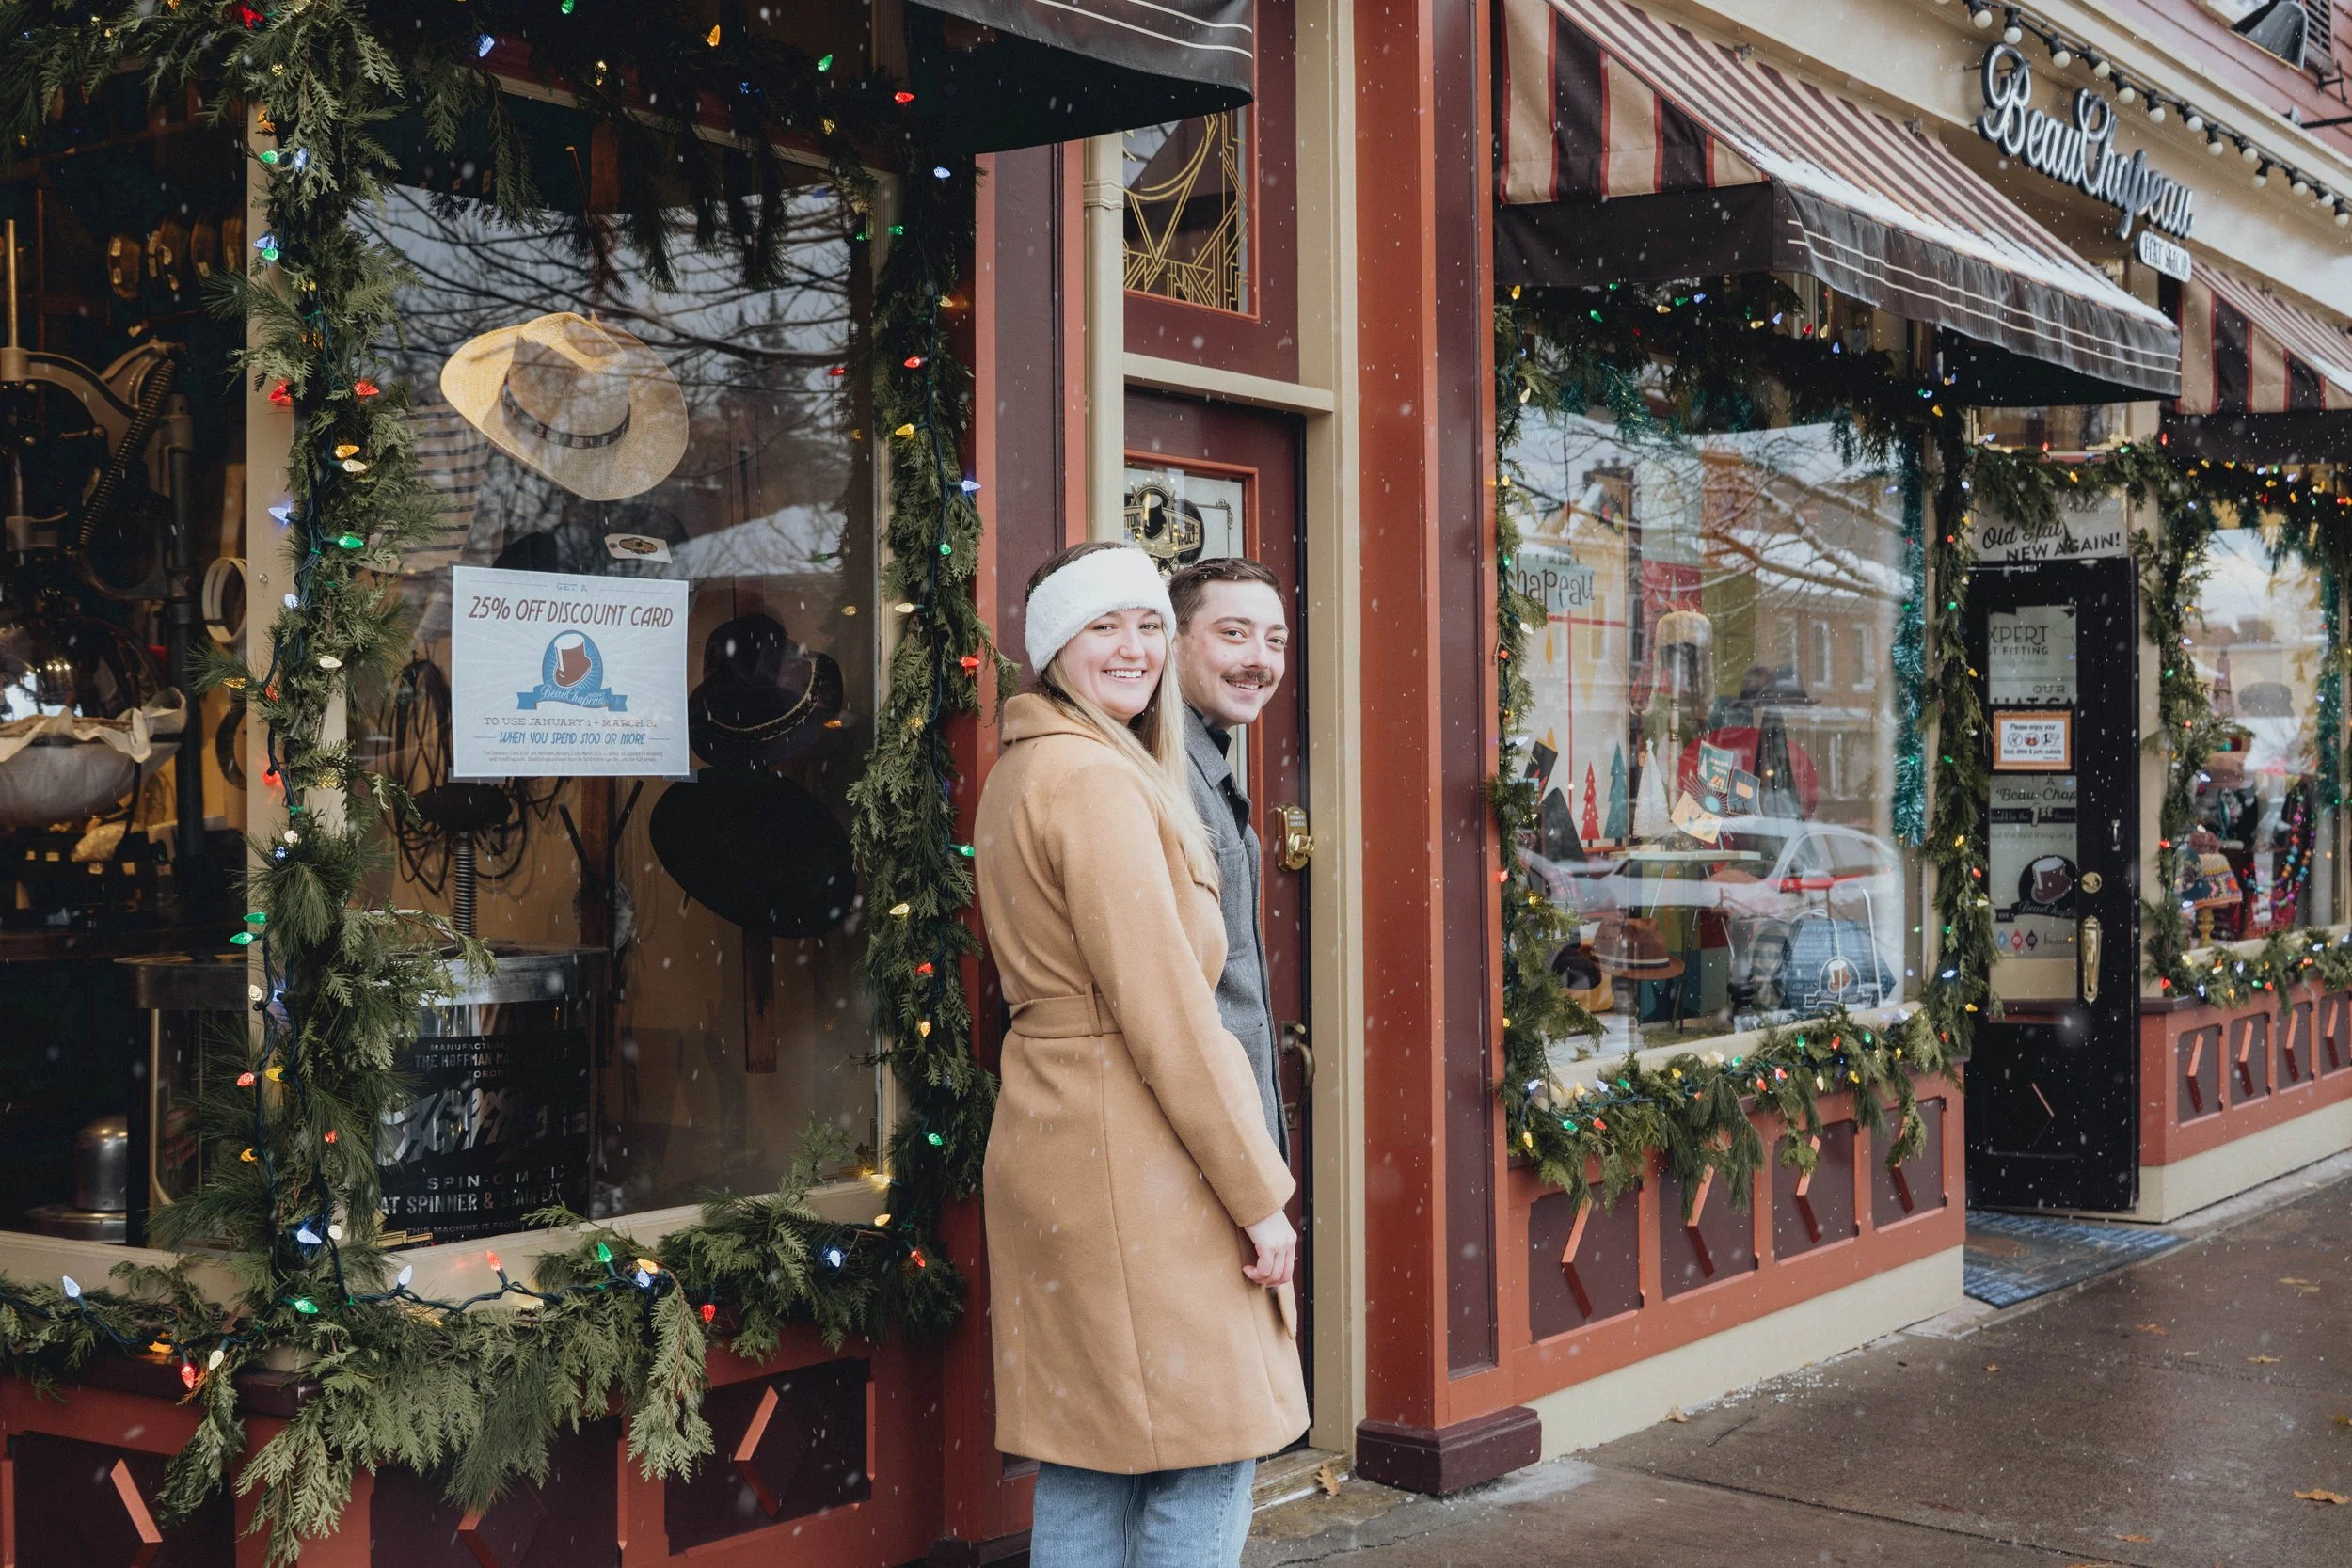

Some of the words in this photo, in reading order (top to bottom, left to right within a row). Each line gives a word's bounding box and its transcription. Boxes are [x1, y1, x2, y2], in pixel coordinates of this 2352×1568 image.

[2144, 237, 2164, 265] HAT
[2165, 246, 2187, 277] SHOP
[1982, 526, 2018, 549] Old
[2006, 543, 2048, 561] NEW
[556, 582, 578, 592] GET
[1516, 553, 1596, 610] hapeau
[469, 596, 511, 620] 25%
[516, 599, 547, 622] OFF
[547, 601, 627, 626] DISCOUNT
[630, 606, 673, 627] CARD
[1990, 626, 2049, 646] XPERT
[2002, 646, 2049, 656] FITTING
[2032, 685, 2066, 694] OUR
[483, 717, 500, 726] TO
[502, 717, 526, 726] USE
[529, 718, 584, 727] JANUARY
[602, 719, 644, 728] MARCH
[499, 731, 526, 745] WHEN
[530, 731, 548, 744] YOU
[551, 732, 577, 745] SPEND
[605, 733, 617, 745] OR
[620, 733, 646, 745] MORE
[414, 1054, 437, 1069] THE
[441, 1053, 492, 1068] HOFFMAN
[380, 1196, 401, 1216] AT
[407, 1192, 479, 1214] SPINNER
[483, 1190, 495, 1210] &
[432, 1224, 479, 1234] MACHINE
